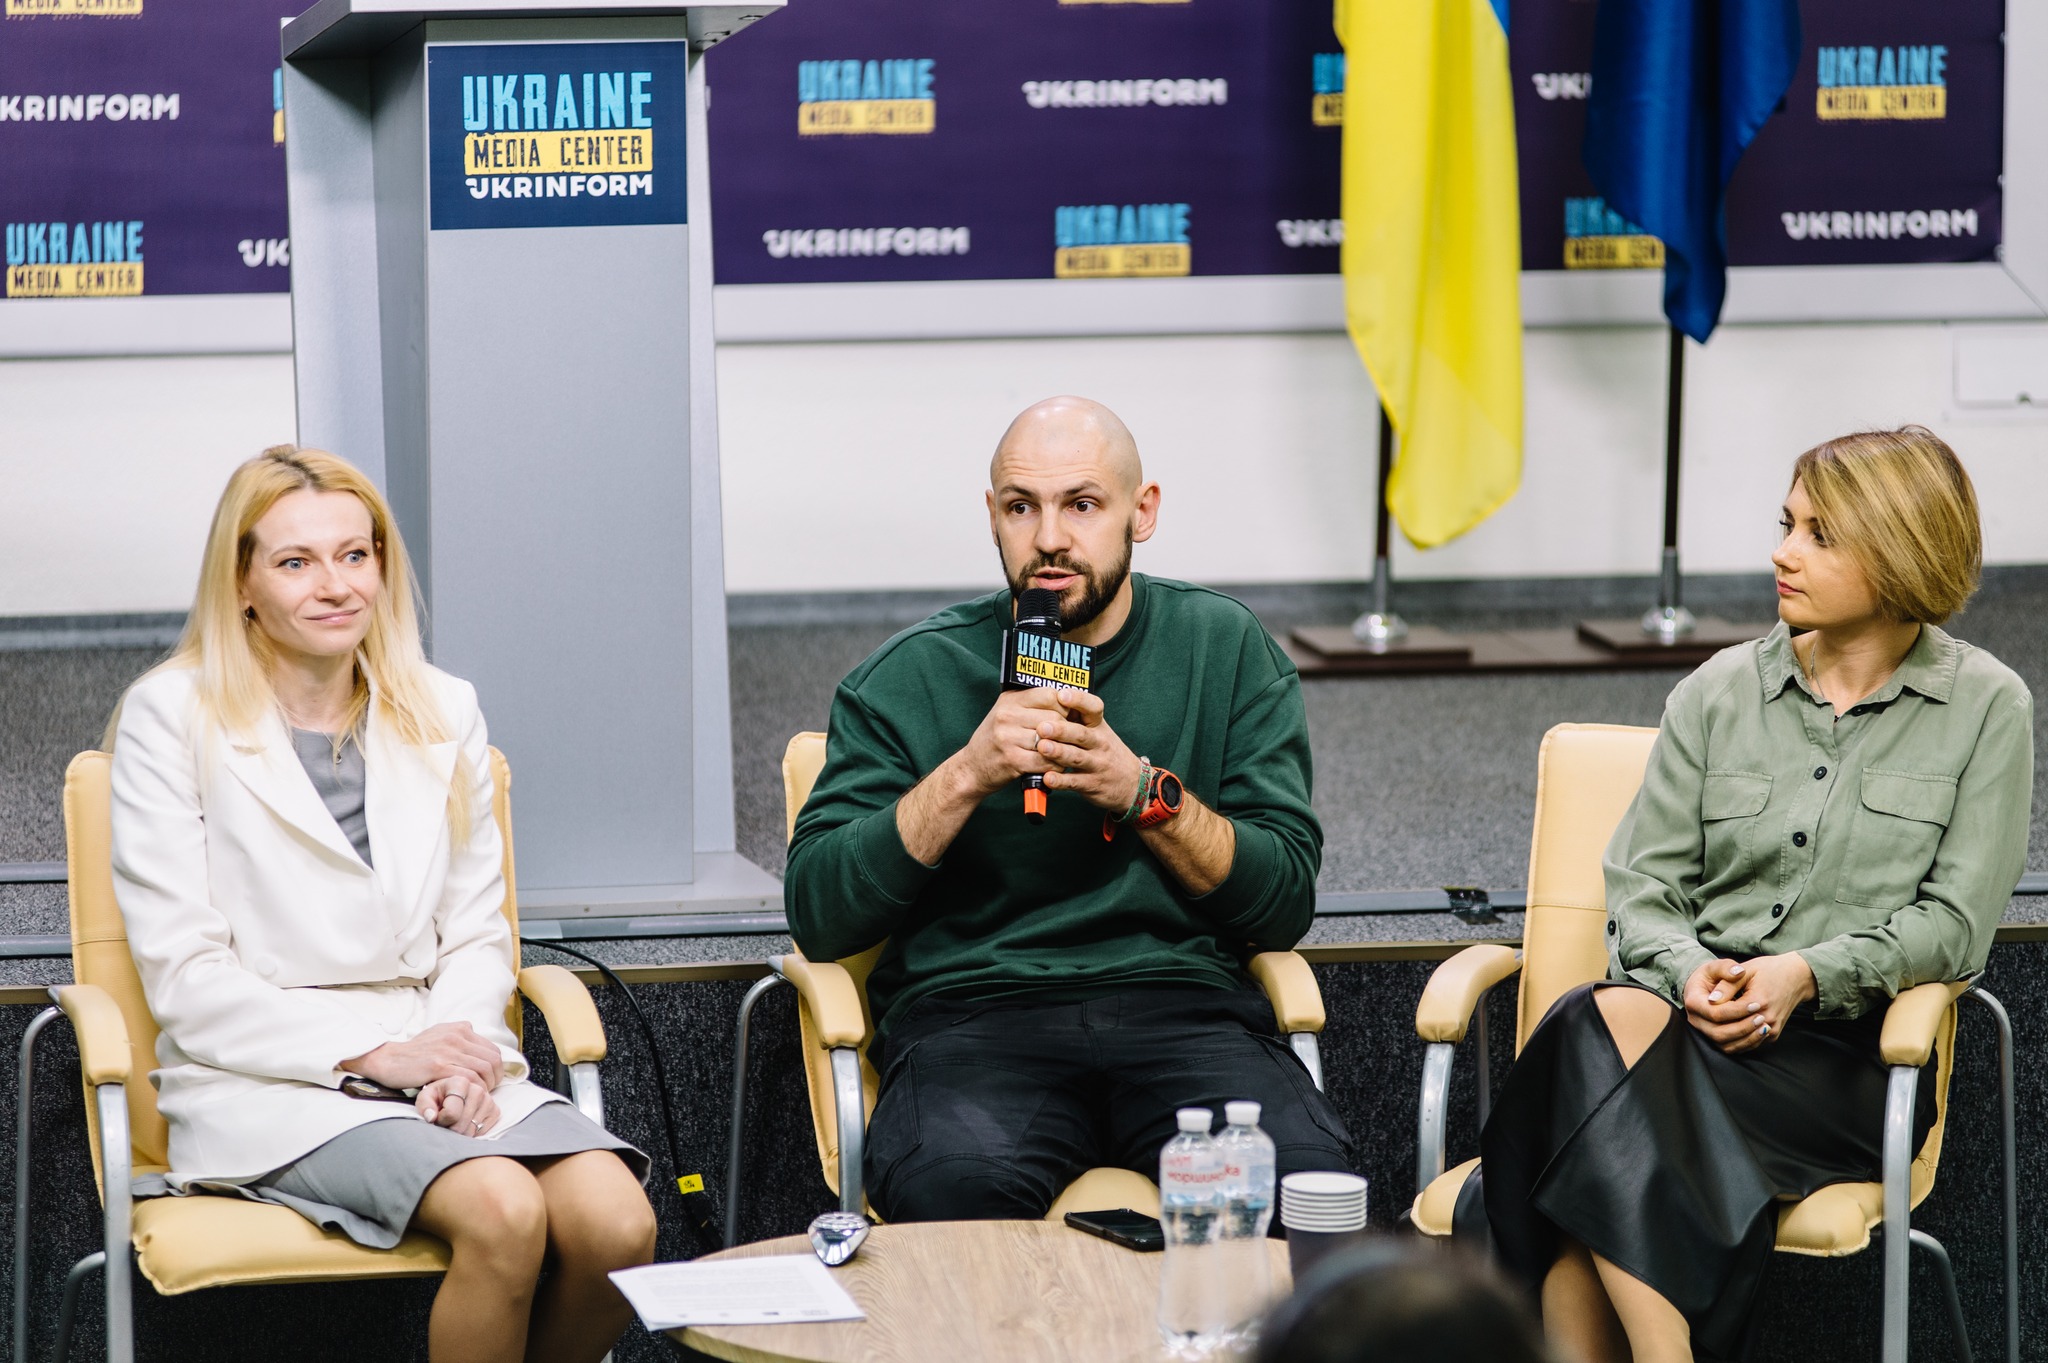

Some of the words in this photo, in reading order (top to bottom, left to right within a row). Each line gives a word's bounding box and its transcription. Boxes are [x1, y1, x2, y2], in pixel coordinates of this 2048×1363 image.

[799, 58, 936, 102] UKRAINE
[1817, 45, 1947, 88] UKRAINE
[462, 71, 653, 131] UKRAINE
[1021, 78, 1228, 108] UKRINFORM
[473, 138, 541, 168] MEDIA
[560, 136, 643, 166] CENTER
[465, 174, 653, 199] UKRINFORM
[1055, 203, 1191, 247] UKRAINE
[1780, 208, 1978, 240] UKRINFORM
[6, 221, 144, 265] UKRAINE
[762, 226, 970, 258] UKRINFORM
[14, 270, 61, 289] MEDIA
[76, 268, 136, 288] CENTER
[1017, 631, 1092, 671] UKRAINE
[1020, 657, 1047, 676] MEDIA
[1053, 665, 1086, 685] CENTER
